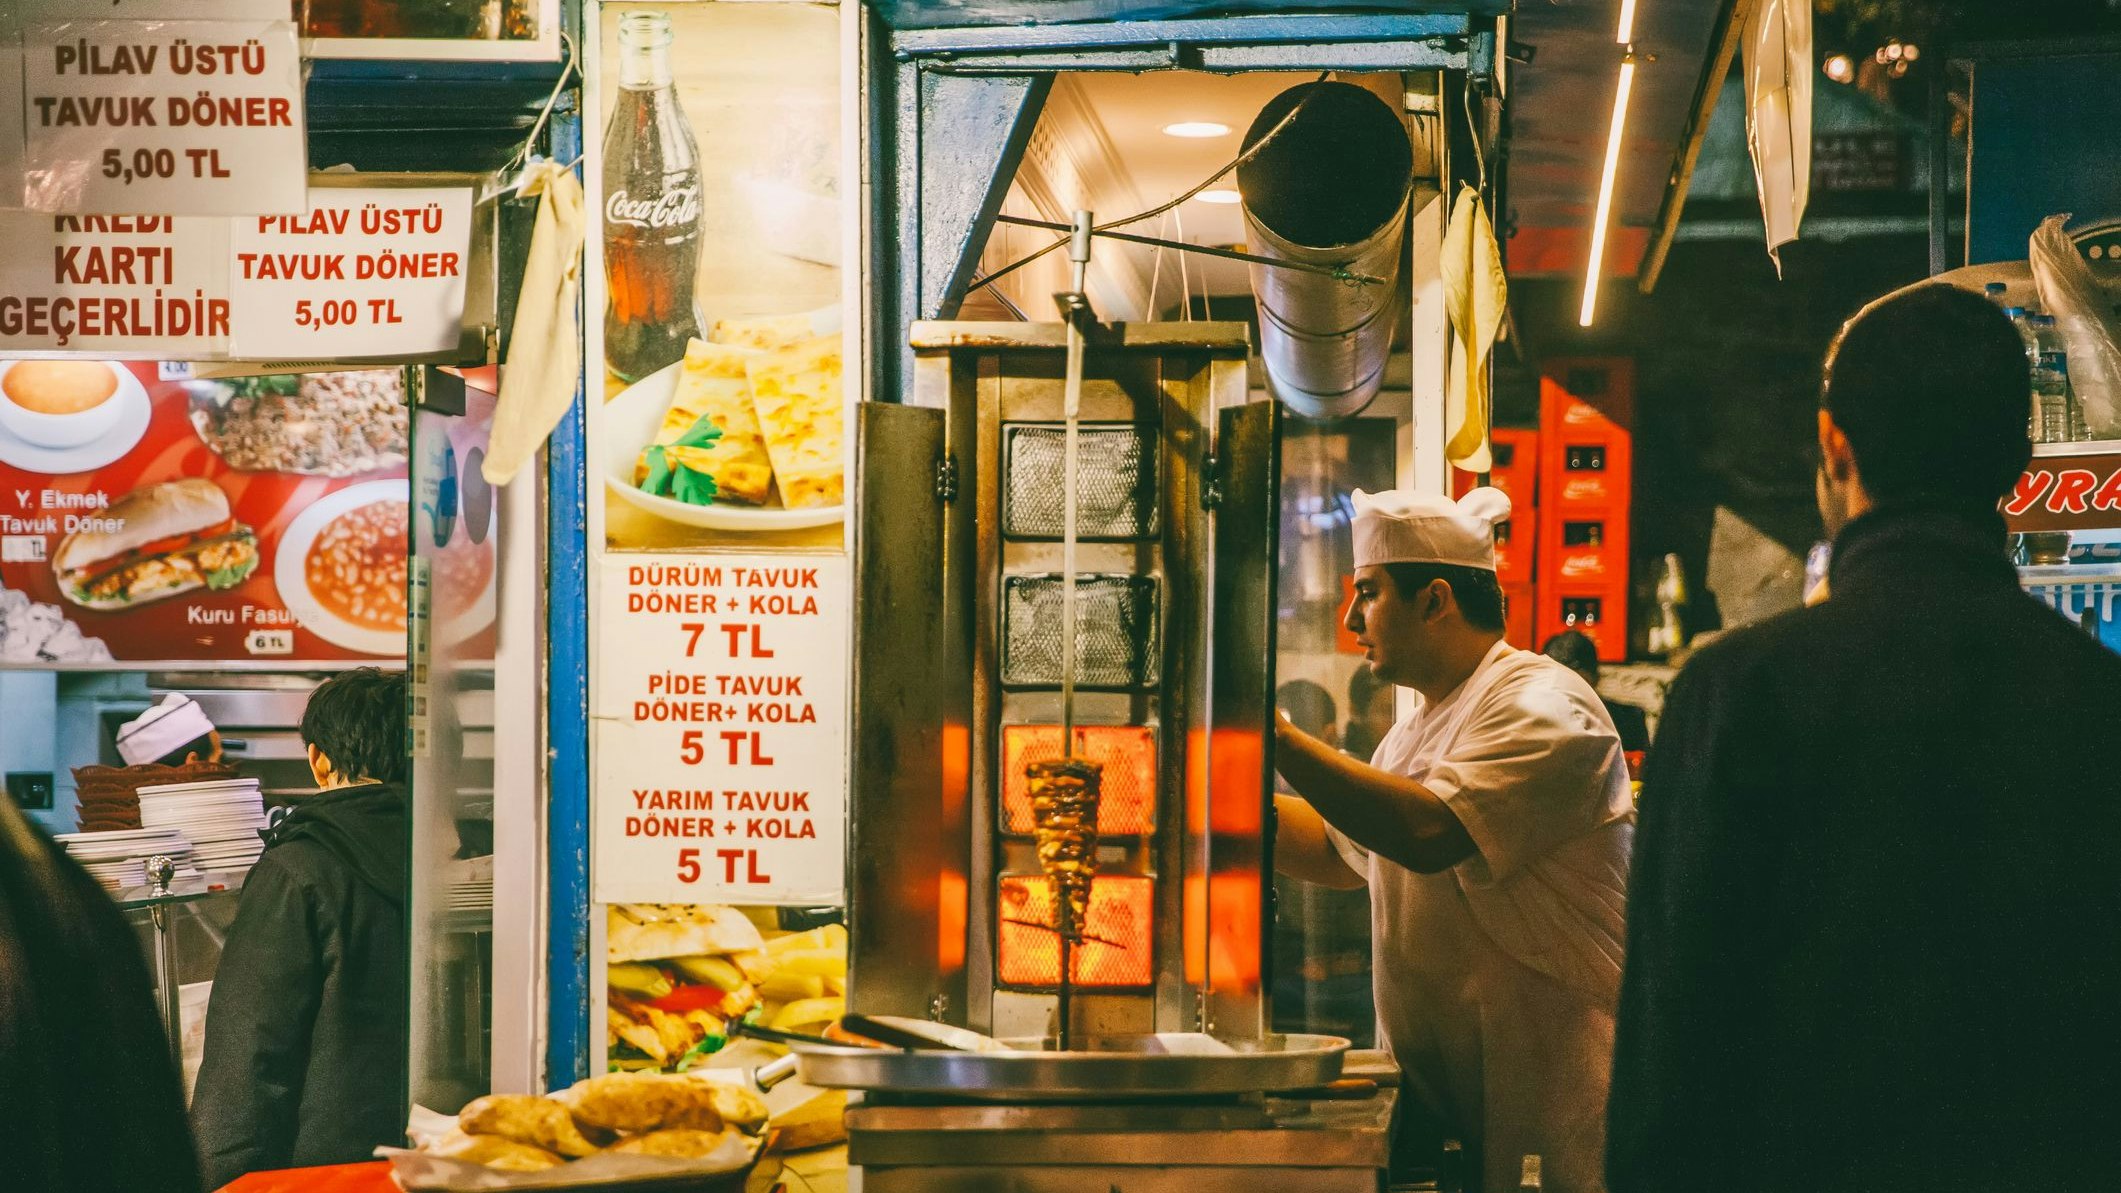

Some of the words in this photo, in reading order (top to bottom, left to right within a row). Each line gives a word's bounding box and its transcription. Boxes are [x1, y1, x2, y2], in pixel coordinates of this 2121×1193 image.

[55, 37, 157, 75] PİLAV
[169, 39, 264, 75] ÜSTÜ
[33, 96, 156, 127] TAVUK
[168, 91, 291, 126] DÖNER
[102, 148, 174, 185] 5,00
[185, 149, 230, 177] TL
[361, 203, 442, 234] ÜSTÜ
[606, 184, 700, 228] Coca-Cola
[54, 246, 172, 284] KARTI
[238, 253, 344, 280] TAVUK
[356, 249, 458, 279] DÖNER
[0, 289, 229, 346] GEÇERLİDİR
[296, 300, 356, 331] 5,00
[368, 299, 402, 323] TL
[15, 489, 34, 509] Y.
[41, 489, 109, 509] Ekmek
[0, 514, 58, 534] Tavuk
[64, 513, 126, 535] Döner
[629, 562, 721, 586] DÜRÜM
[733, 569, 817, 588] TAVUK
[187, 605, 235, 624] Kuru
[629, 589, 716, 613] DÖNER
[727, 597, 739, 611] +
[750, 596, 817, 615] KOLA
[682, 624, 704, 656] 7
[721, 624, 773, 658] TL
[649, 670, 706, 694] PİDE
[716, 676, 802, 696] TAVUK
[748, 703, 816, 723] KOLA
[681, 731, 703, 765] 5
[721, 732, 773, 765] TL
[633, 790, 712, 810] YARIM
[723, 791, 809, 811] TAVUK
[626, 813, 714, 837] DÖNER
[724, 821, 736, 835] +
[747, 818, 815, 838] KOLA
[678, 849, 700, 883] 5
[717, 849, 770, 883] TL
